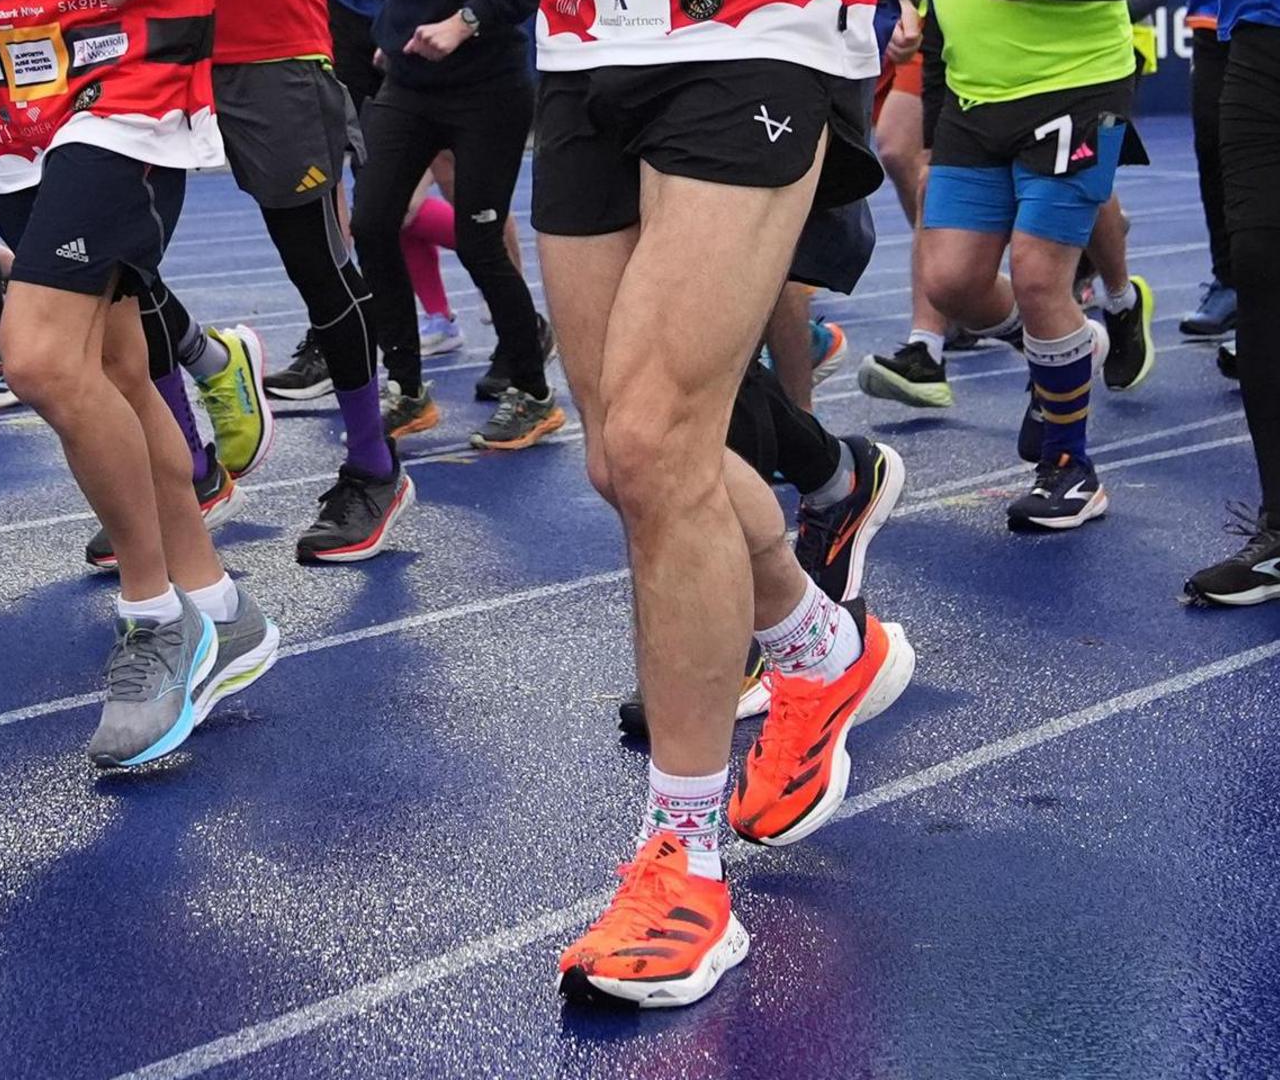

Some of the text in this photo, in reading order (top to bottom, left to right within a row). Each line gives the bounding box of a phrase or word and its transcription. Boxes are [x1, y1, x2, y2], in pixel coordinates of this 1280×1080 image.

[85, 35, 125, 50] Mattioli
[1034, 114, 1073, 175] 7
[56, 247, 89, 263] adidas
